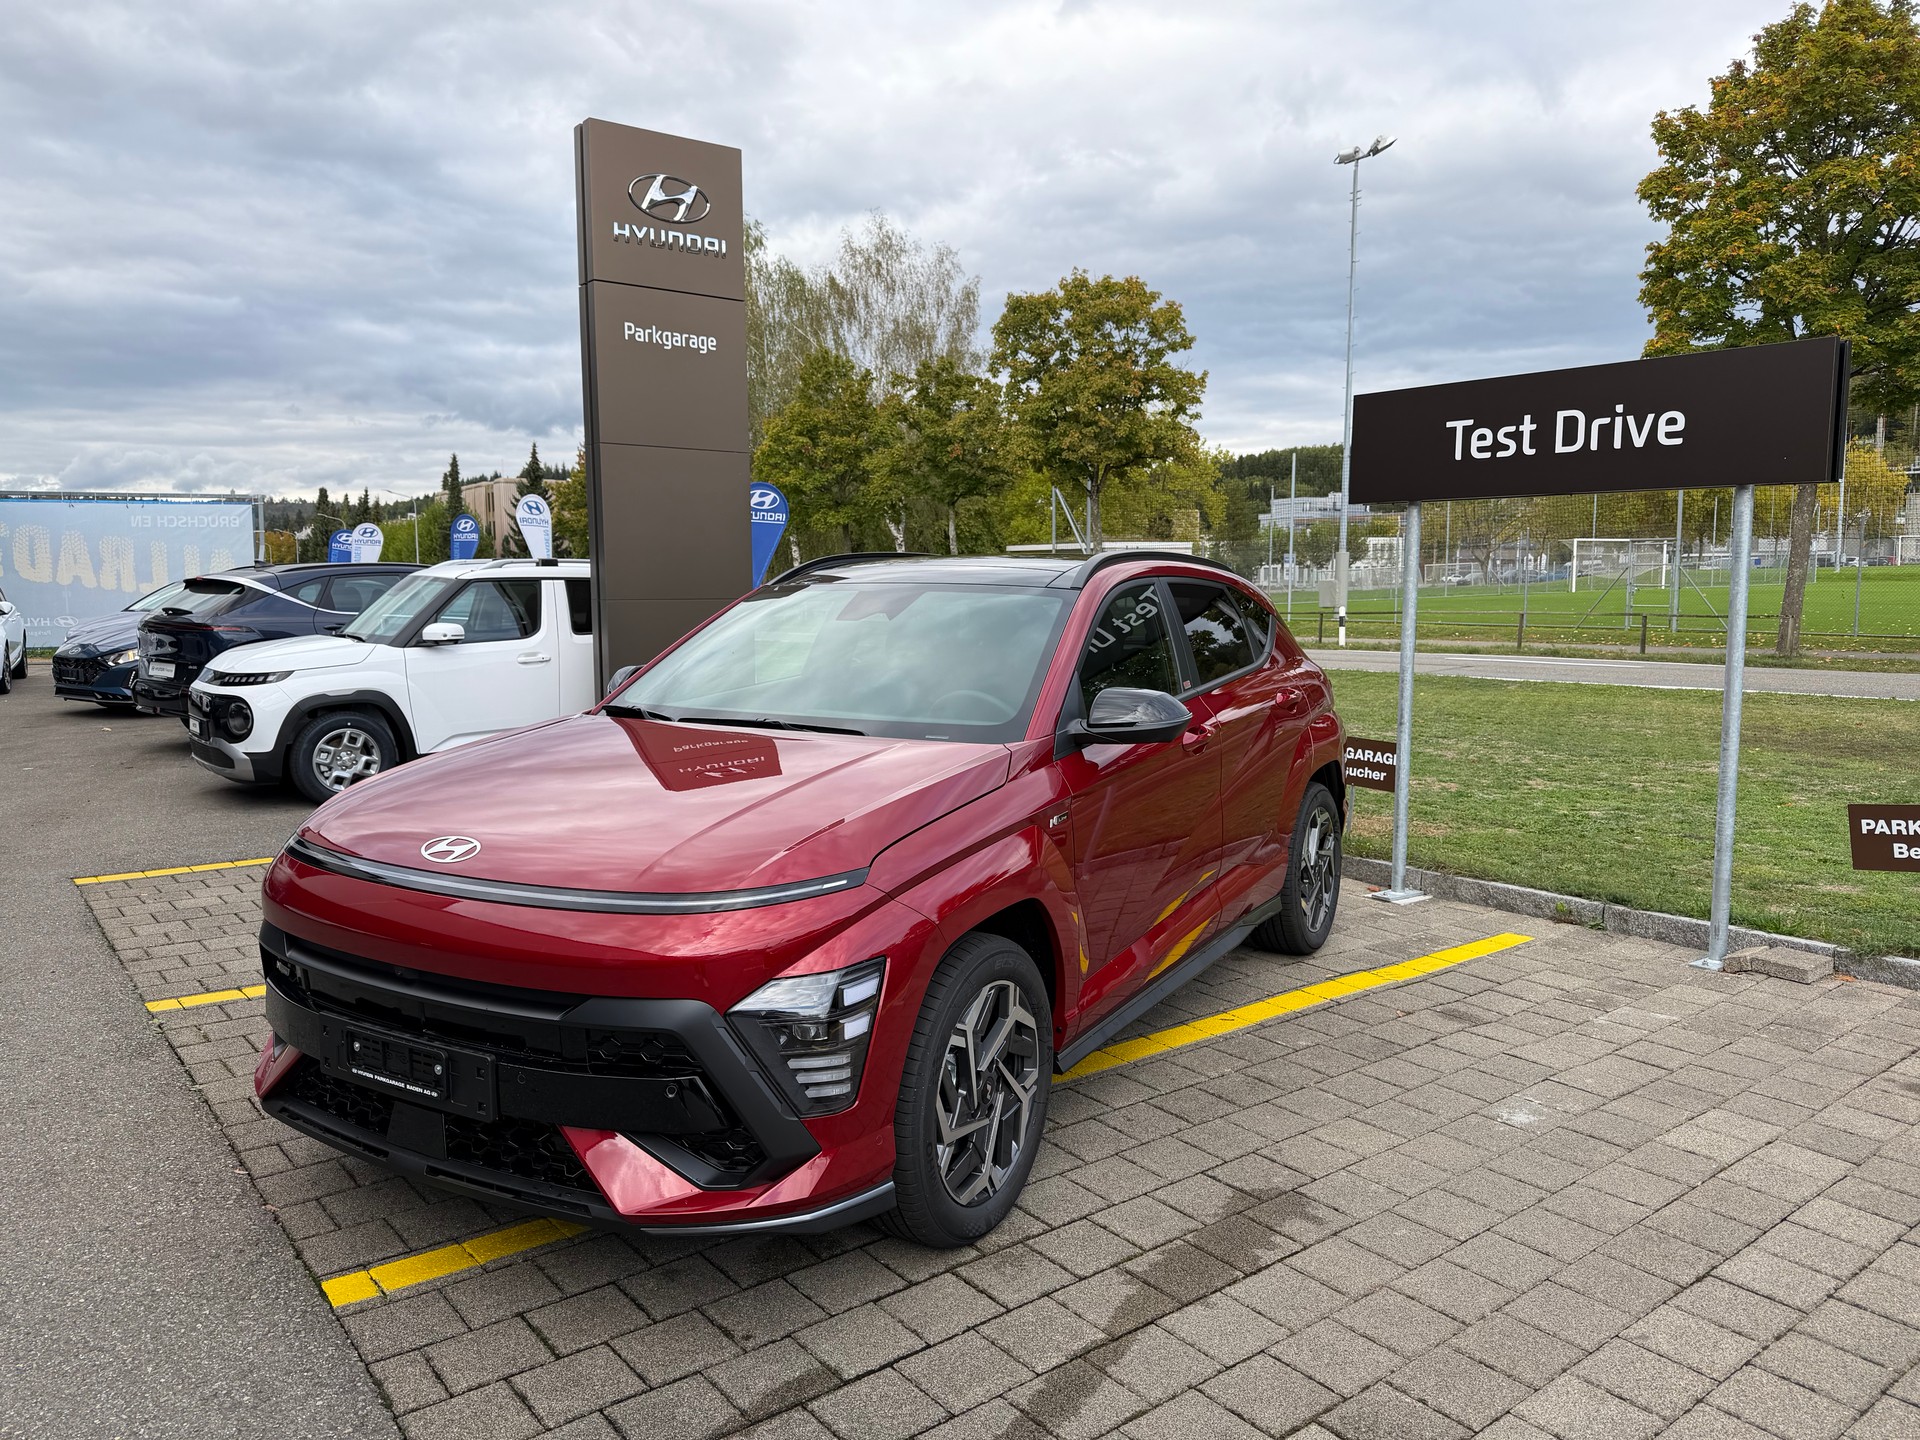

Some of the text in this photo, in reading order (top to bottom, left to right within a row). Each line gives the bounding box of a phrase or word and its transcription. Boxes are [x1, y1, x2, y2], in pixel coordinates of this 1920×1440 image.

[613, 222, 727, 259] HYUNDAI
[624, 322, 717, 354] Parkgarage
[1446, 404, 1686, 461] Test Drive
[751, 511, 786, 521] UNDAI
[1344, 747, 1397, 766] GARAG
[1860, 819, 1920, 836] PARK
[1893, 843, 1920, 859] Be
